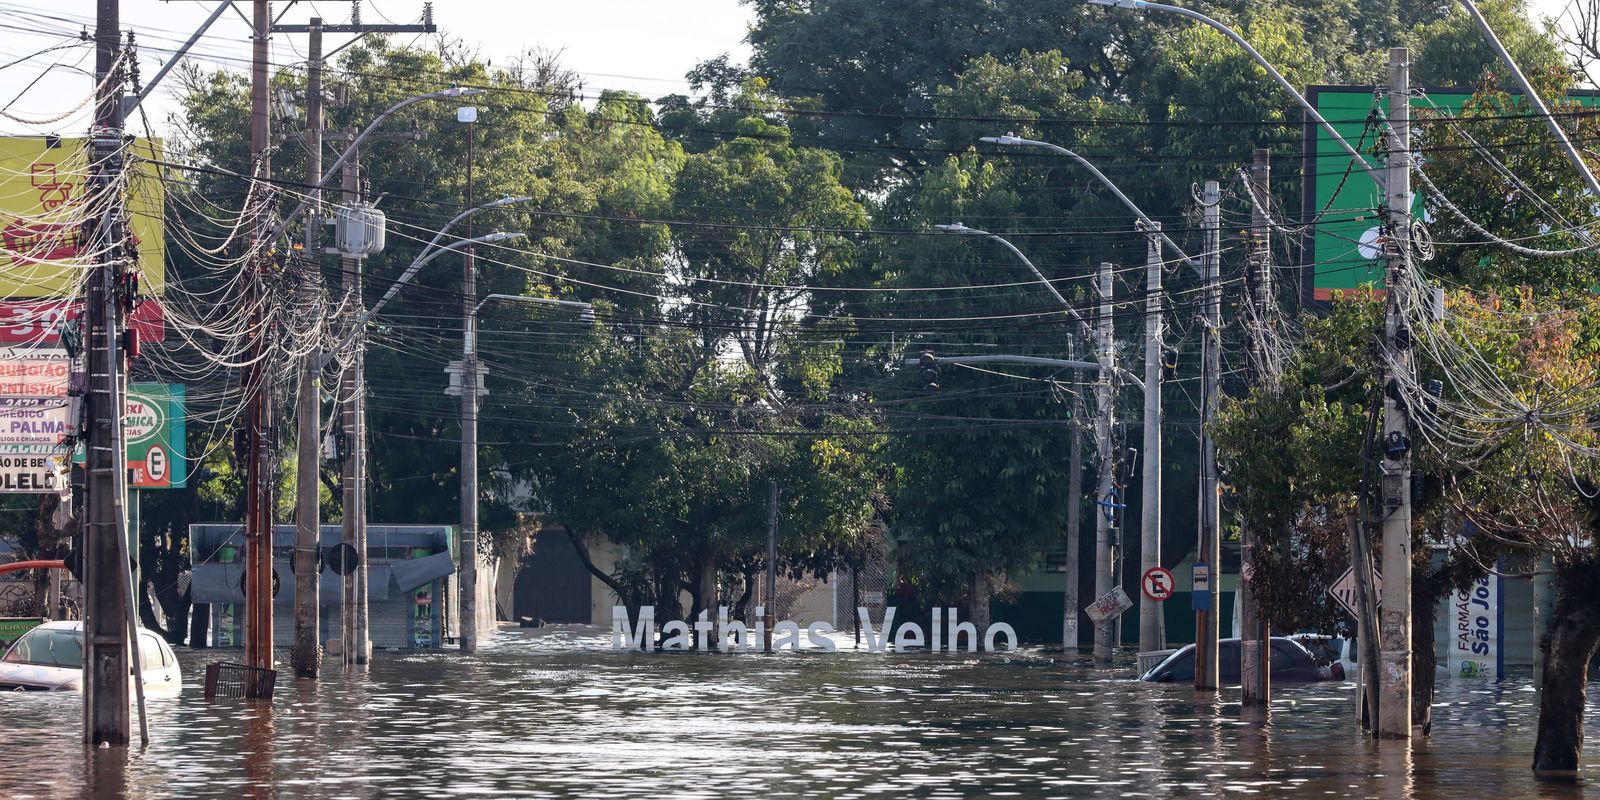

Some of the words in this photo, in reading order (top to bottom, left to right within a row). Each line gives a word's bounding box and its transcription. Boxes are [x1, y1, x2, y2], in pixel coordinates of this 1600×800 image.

[11, 421, 64, 433] PALMA
[14, 458, 28, 467] DE
[612, 605, 836, 651] Mathias
[857, 606, 1018, 652] Velho
[1471, 616, 1489, 656] São
